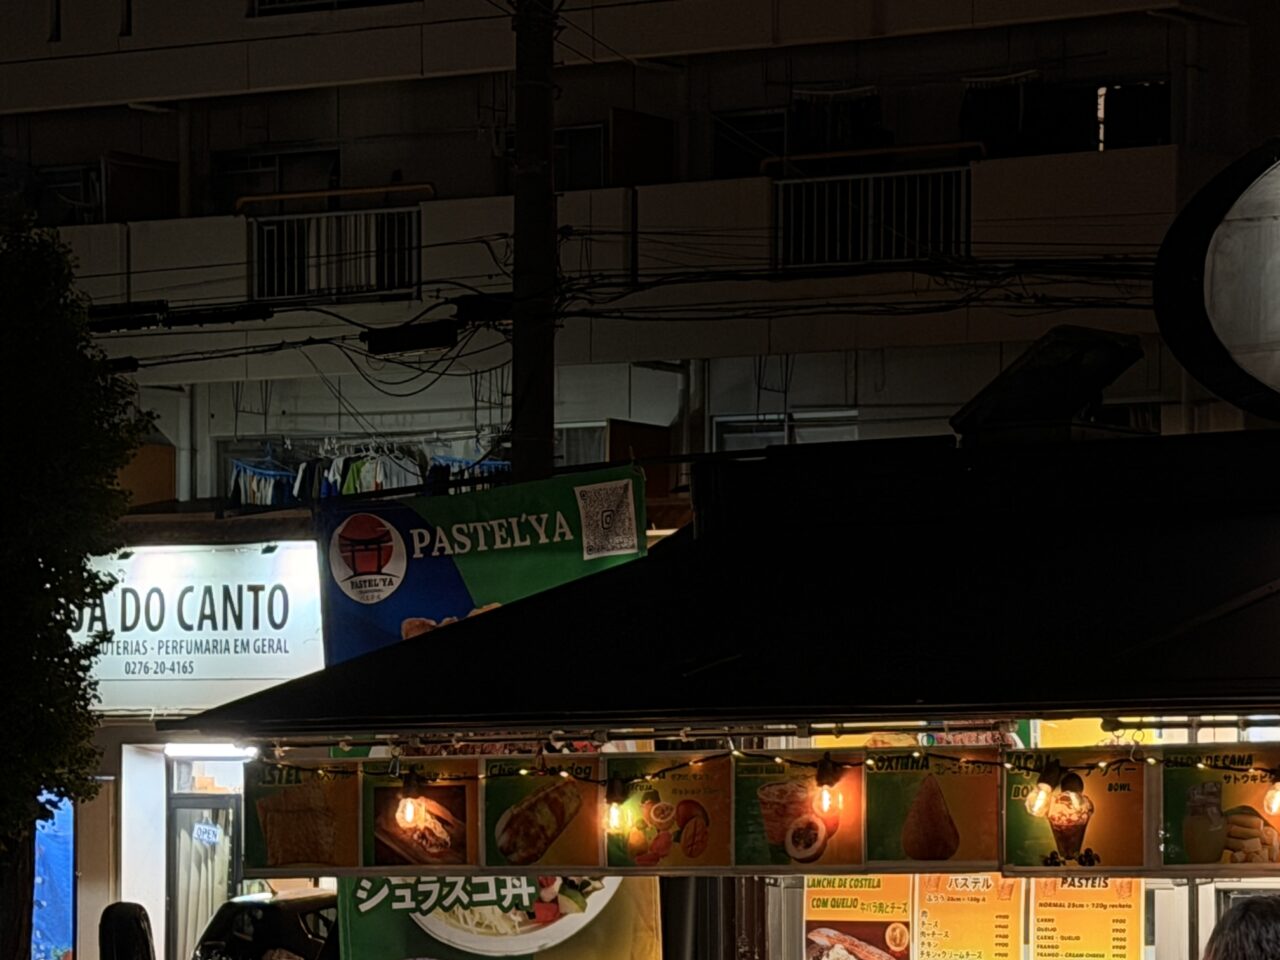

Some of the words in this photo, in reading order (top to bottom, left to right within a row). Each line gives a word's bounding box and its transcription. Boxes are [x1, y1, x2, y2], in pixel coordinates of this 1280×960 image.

[409, 510, 575, 559] PASTEL'YA
[120, 587, 165, 632] DO
[177, 584, 289, 632] CANTO
[101, 640, 148, 656] UTERIAS
[157, 638, 231, 656] PERFUMARIA
[234, 638, 250, 654] EM
[253, 638, 289, 654] GERAL
[124, 661, 194, 675] 0276-20-4165
[1205, 756, 1221, 768] DE
[1222, 755, 1253, 768] CANA
[1107, 782, 1132, 793] BOWL
[807, 878, 836, 889] LANCHE
[837, 878, 847, 889] DE
[848, 878, 881, 889] COSTELA
[948, 877, 992, 890] パステル
[1060, 877, 1109, 889] PASTEIS
[811, 897, 828, 909] COM
[830, 897, 858, 909] QUEIJO
